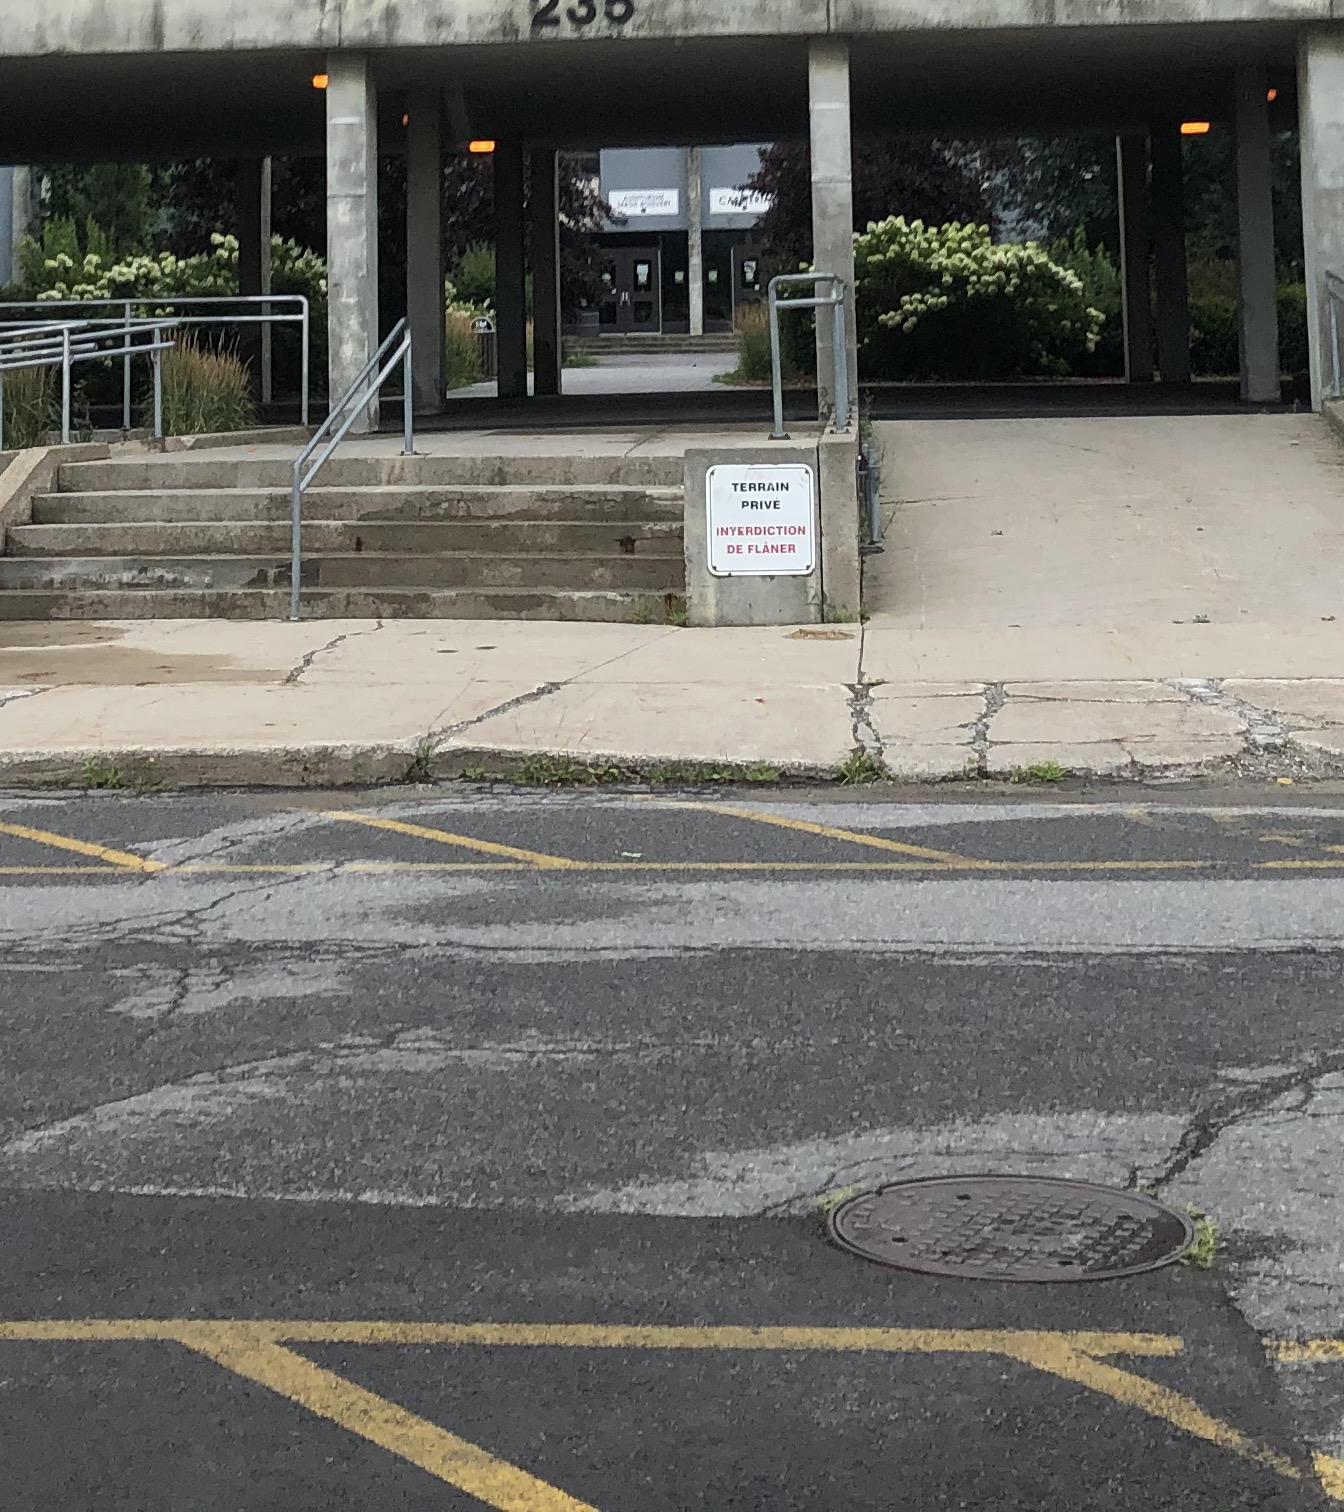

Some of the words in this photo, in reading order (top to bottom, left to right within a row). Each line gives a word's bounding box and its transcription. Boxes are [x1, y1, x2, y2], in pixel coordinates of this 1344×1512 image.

[731, 482, 789, 492] TERRAIN
[741, 497, 781, 510] PRIVÉ
[716, 526, 806, 536] INTERDICTION
[727, 544, 743, 554] DE
[748, 541, 796, 554] FLÂNER
